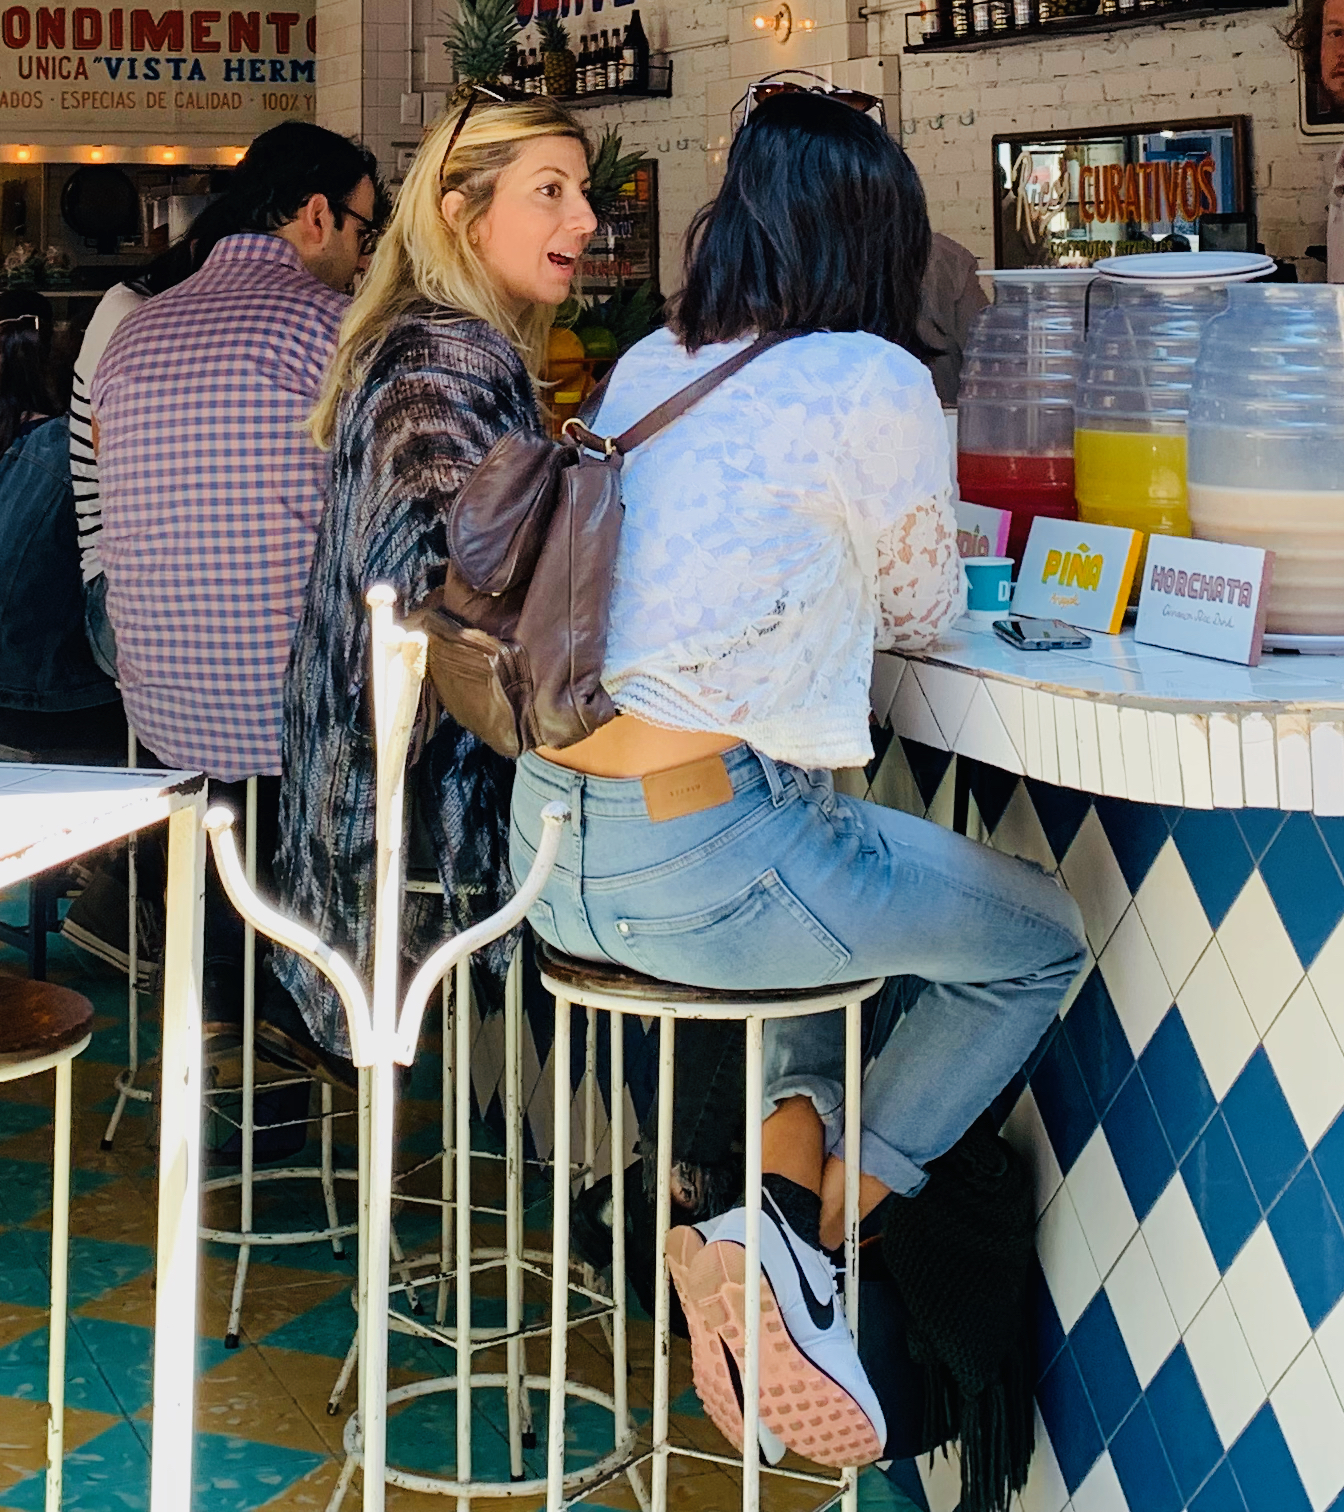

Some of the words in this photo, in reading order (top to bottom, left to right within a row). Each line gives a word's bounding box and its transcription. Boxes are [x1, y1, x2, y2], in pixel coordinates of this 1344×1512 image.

[18, 55, 90, 81] UNICA
[60, 90, 137, 110] ESPECIAS
[145, 91, 167, 110] DE
[174, 91, 243, 111] CALIDAD
[261, 92, 299, 112] 100%
[1078, 155, 1218, 224] CURATIVOS
[1040, 542, 1104, 592] PIÑA
[1150, 564, 1254, 609] HORCHATA
